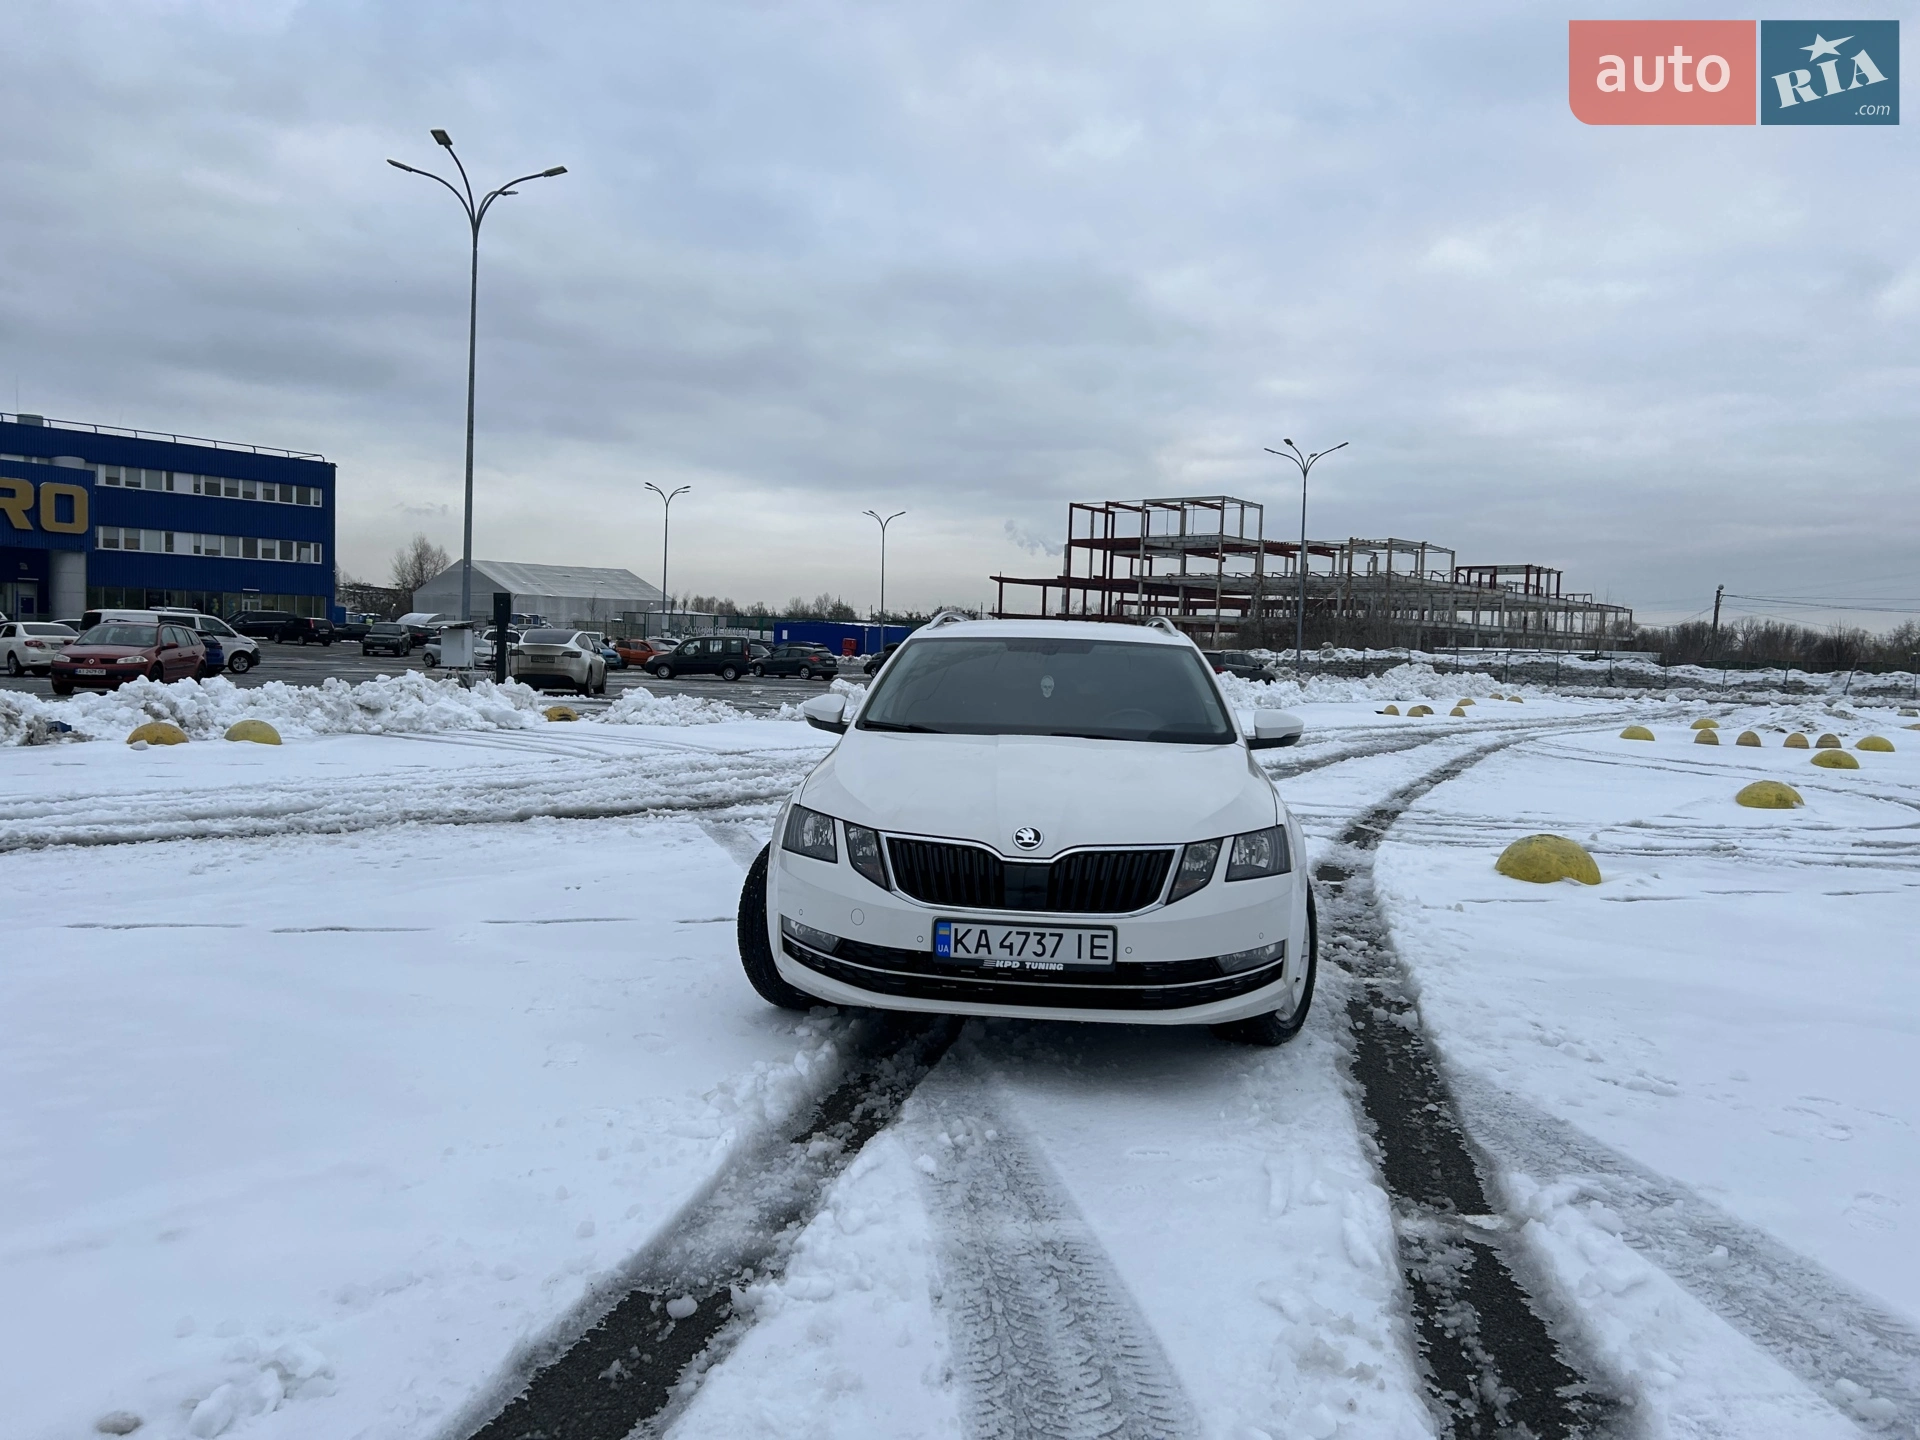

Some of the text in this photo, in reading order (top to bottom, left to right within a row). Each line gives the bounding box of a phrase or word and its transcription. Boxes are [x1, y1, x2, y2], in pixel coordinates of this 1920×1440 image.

[938, 944, 949, 953] UA
[953, 927, 1109, 960] KA 4737 IE
[995, 960, 1064, 971] KPD TUNING
